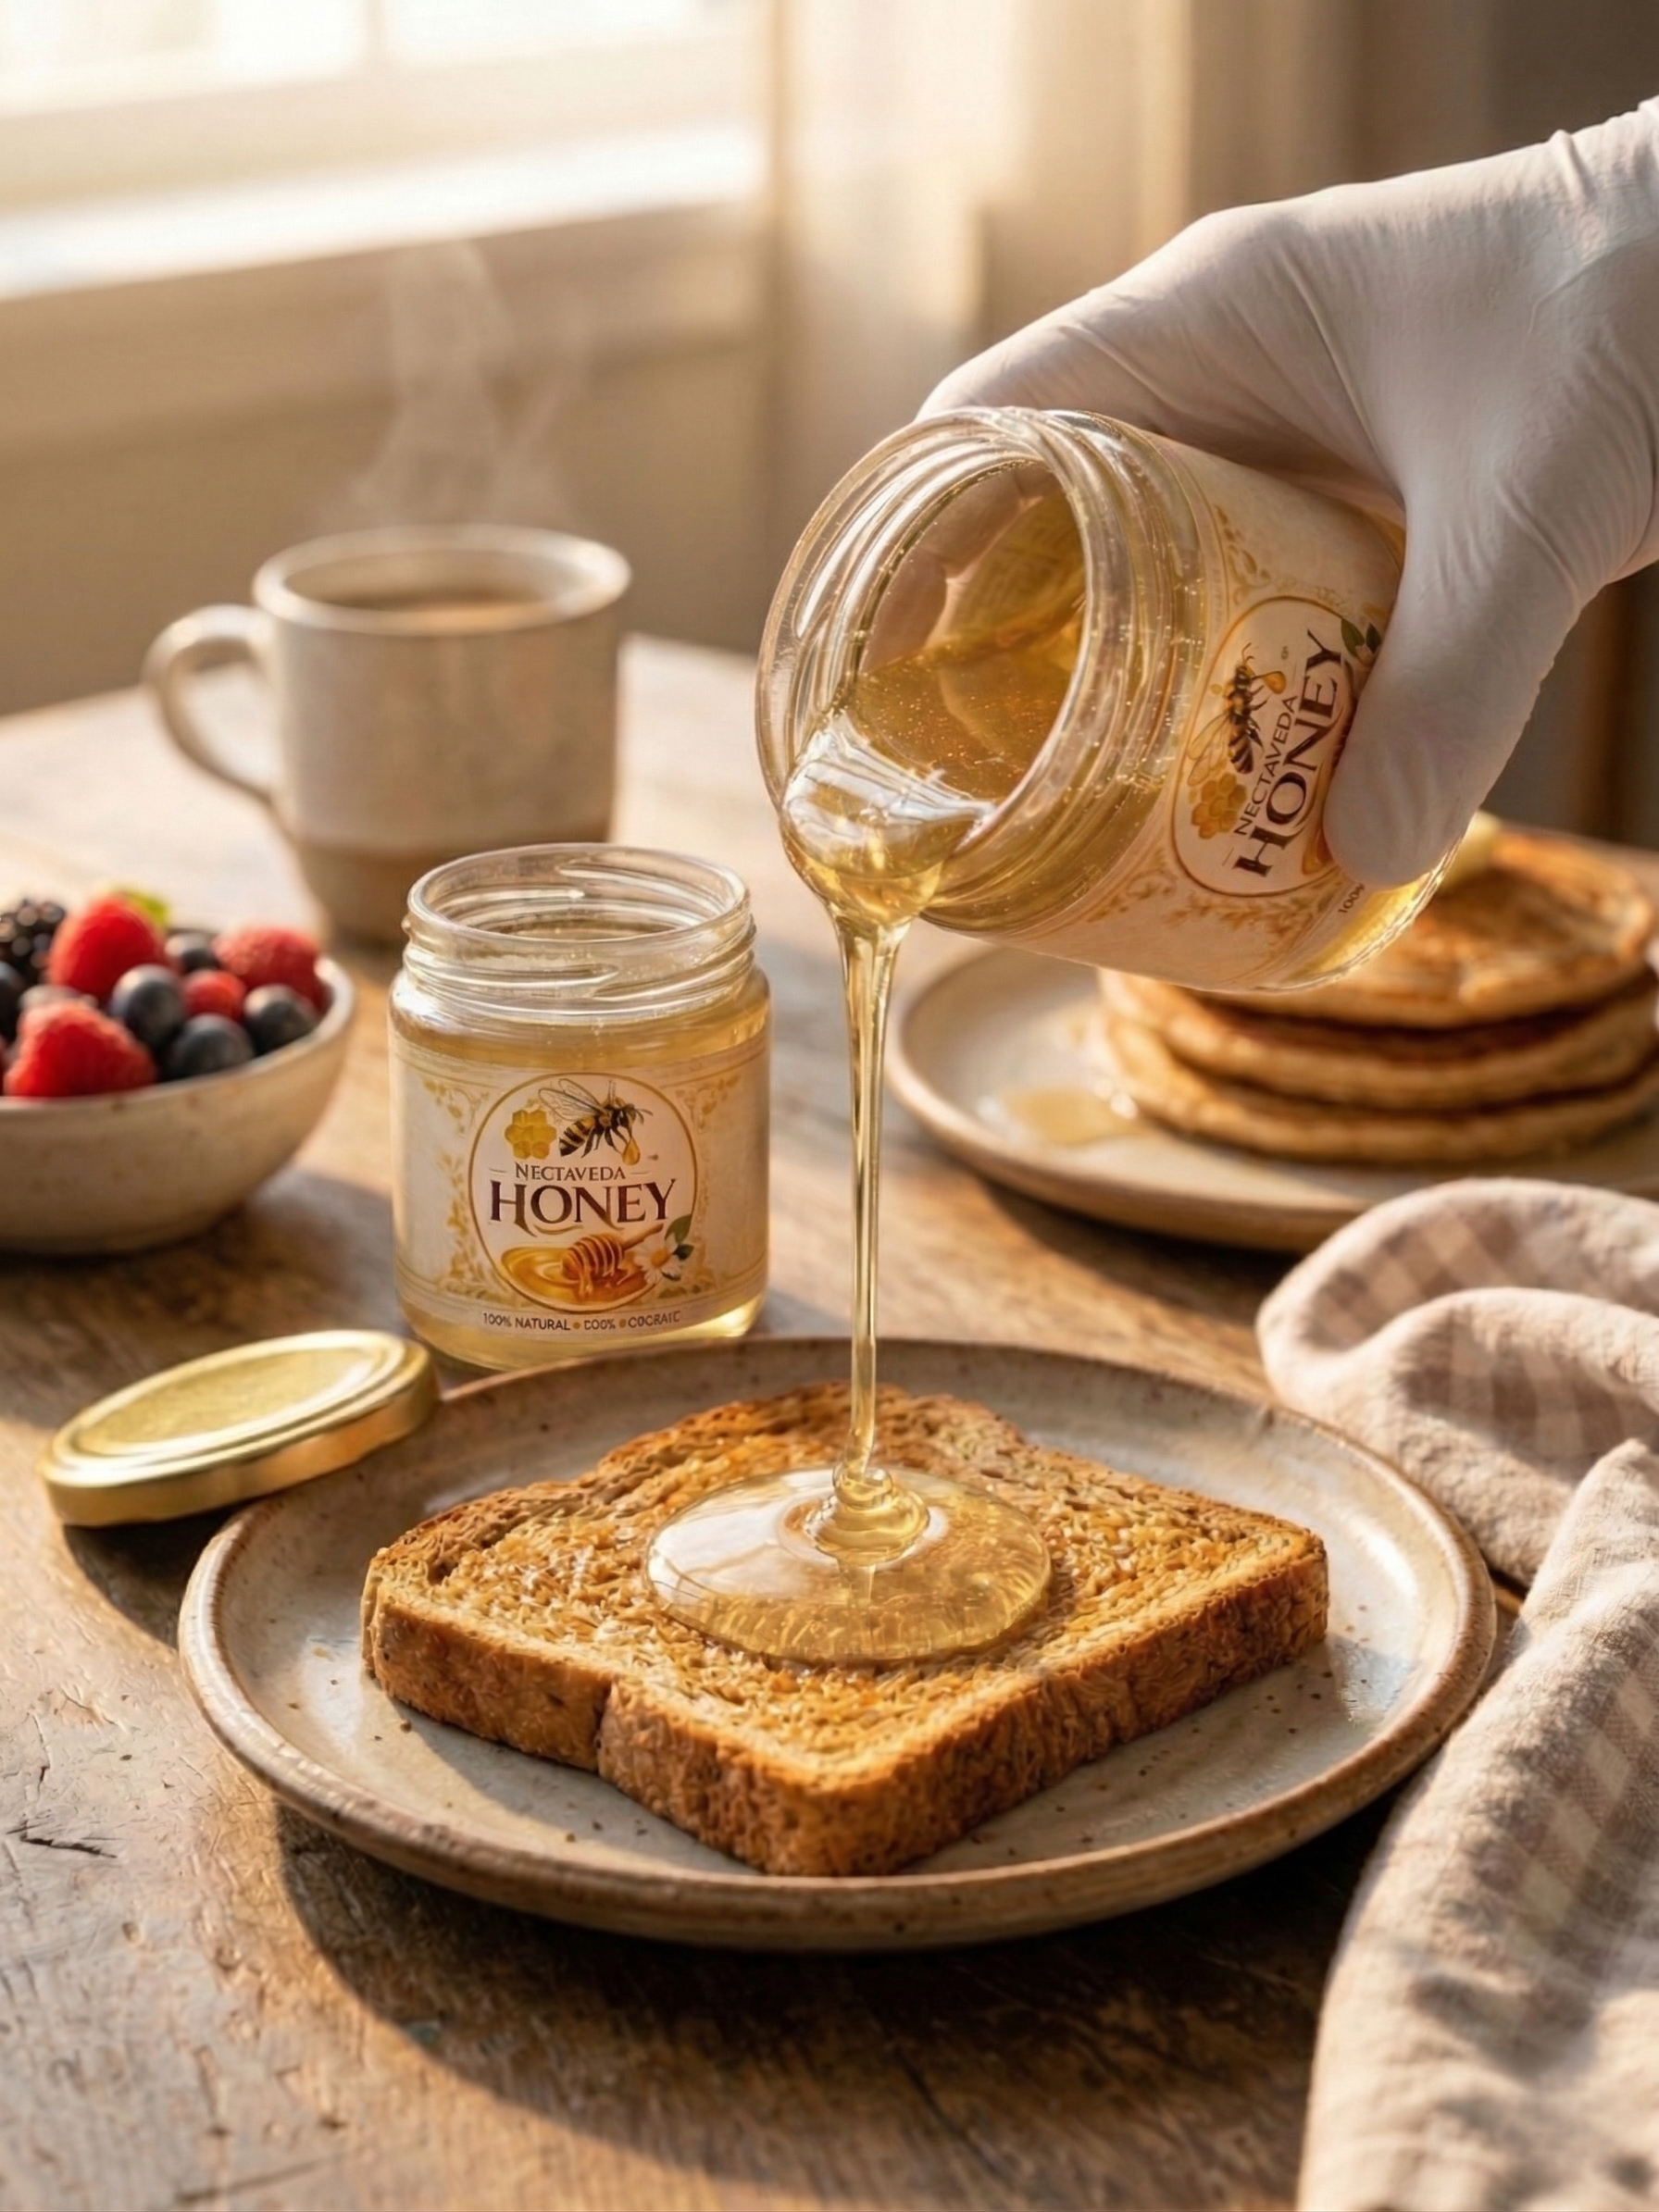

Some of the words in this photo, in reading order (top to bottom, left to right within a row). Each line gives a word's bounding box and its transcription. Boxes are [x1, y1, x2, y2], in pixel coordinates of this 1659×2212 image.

[1233, 628, 1341, 877] HONEY
[1233, 695, 1298, 835] NECTAVEDA
[515, 1162, 626, 1181] NECTAVEDA
[490, 1178, 677, 1237] HONEY
[483, 1312, 512, 1327] 100%
[515, 1317, 571, 1331] NATURAL
